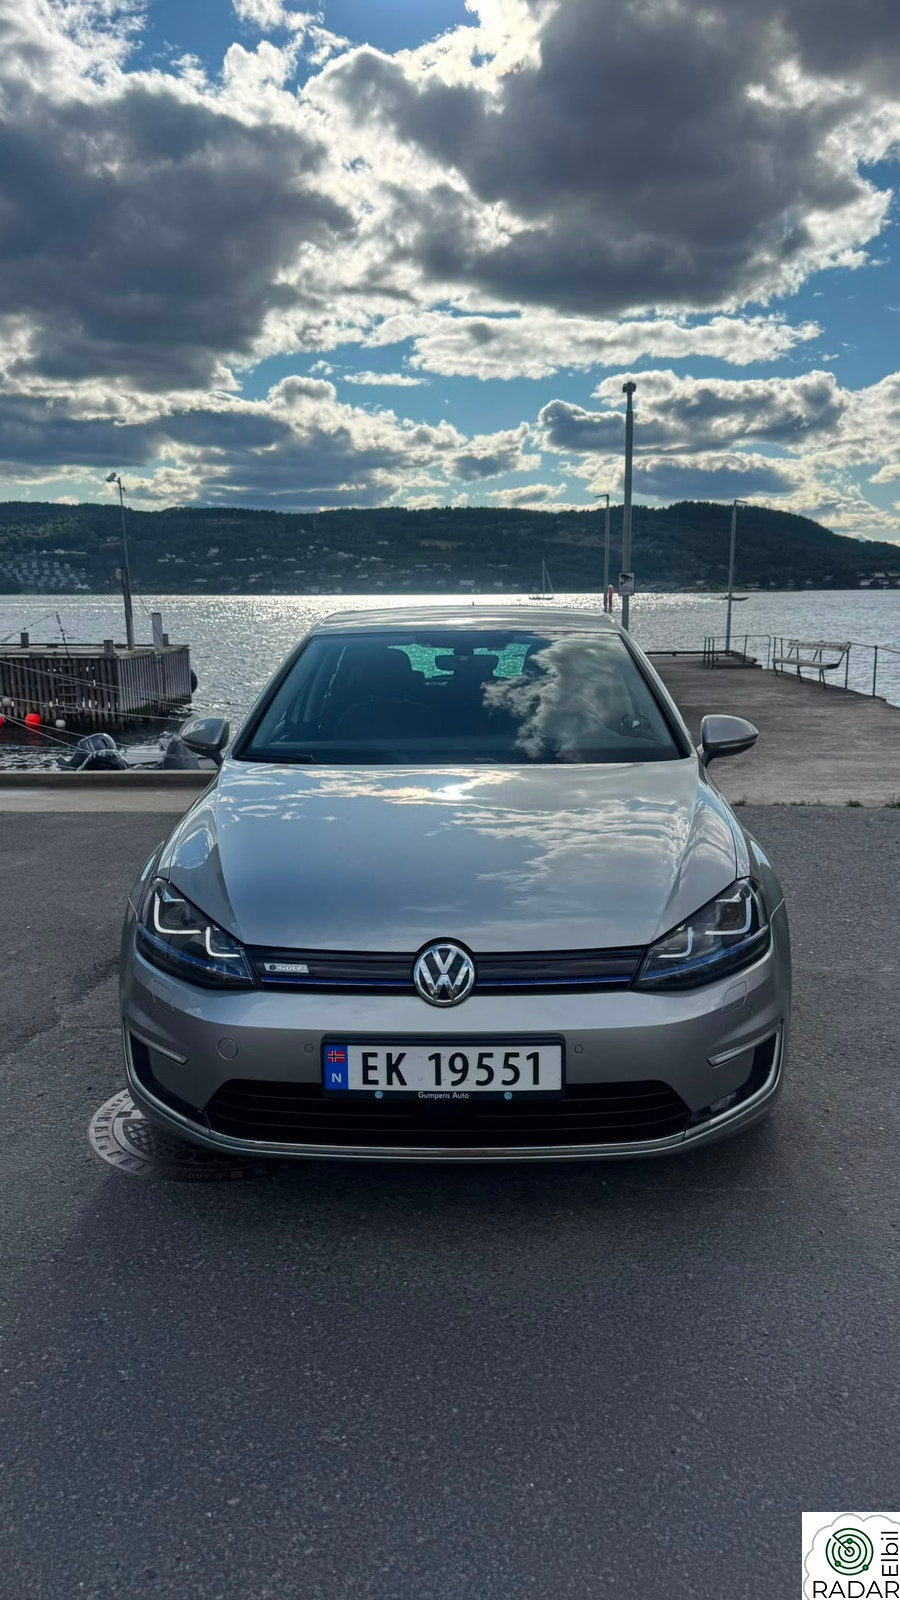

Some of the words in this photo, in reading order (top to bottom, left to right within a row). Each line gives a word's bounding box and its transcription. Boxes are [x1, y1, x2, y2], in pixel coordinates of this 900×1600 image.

[361, 1051, 407, 1085] EK
[428, 1051, 540, 1086] 19551
[331, 1072, 342, 1083] N
[418, 1091, 451, 1100] Gumpens
[452, 1091, 470, 1099] Auto
